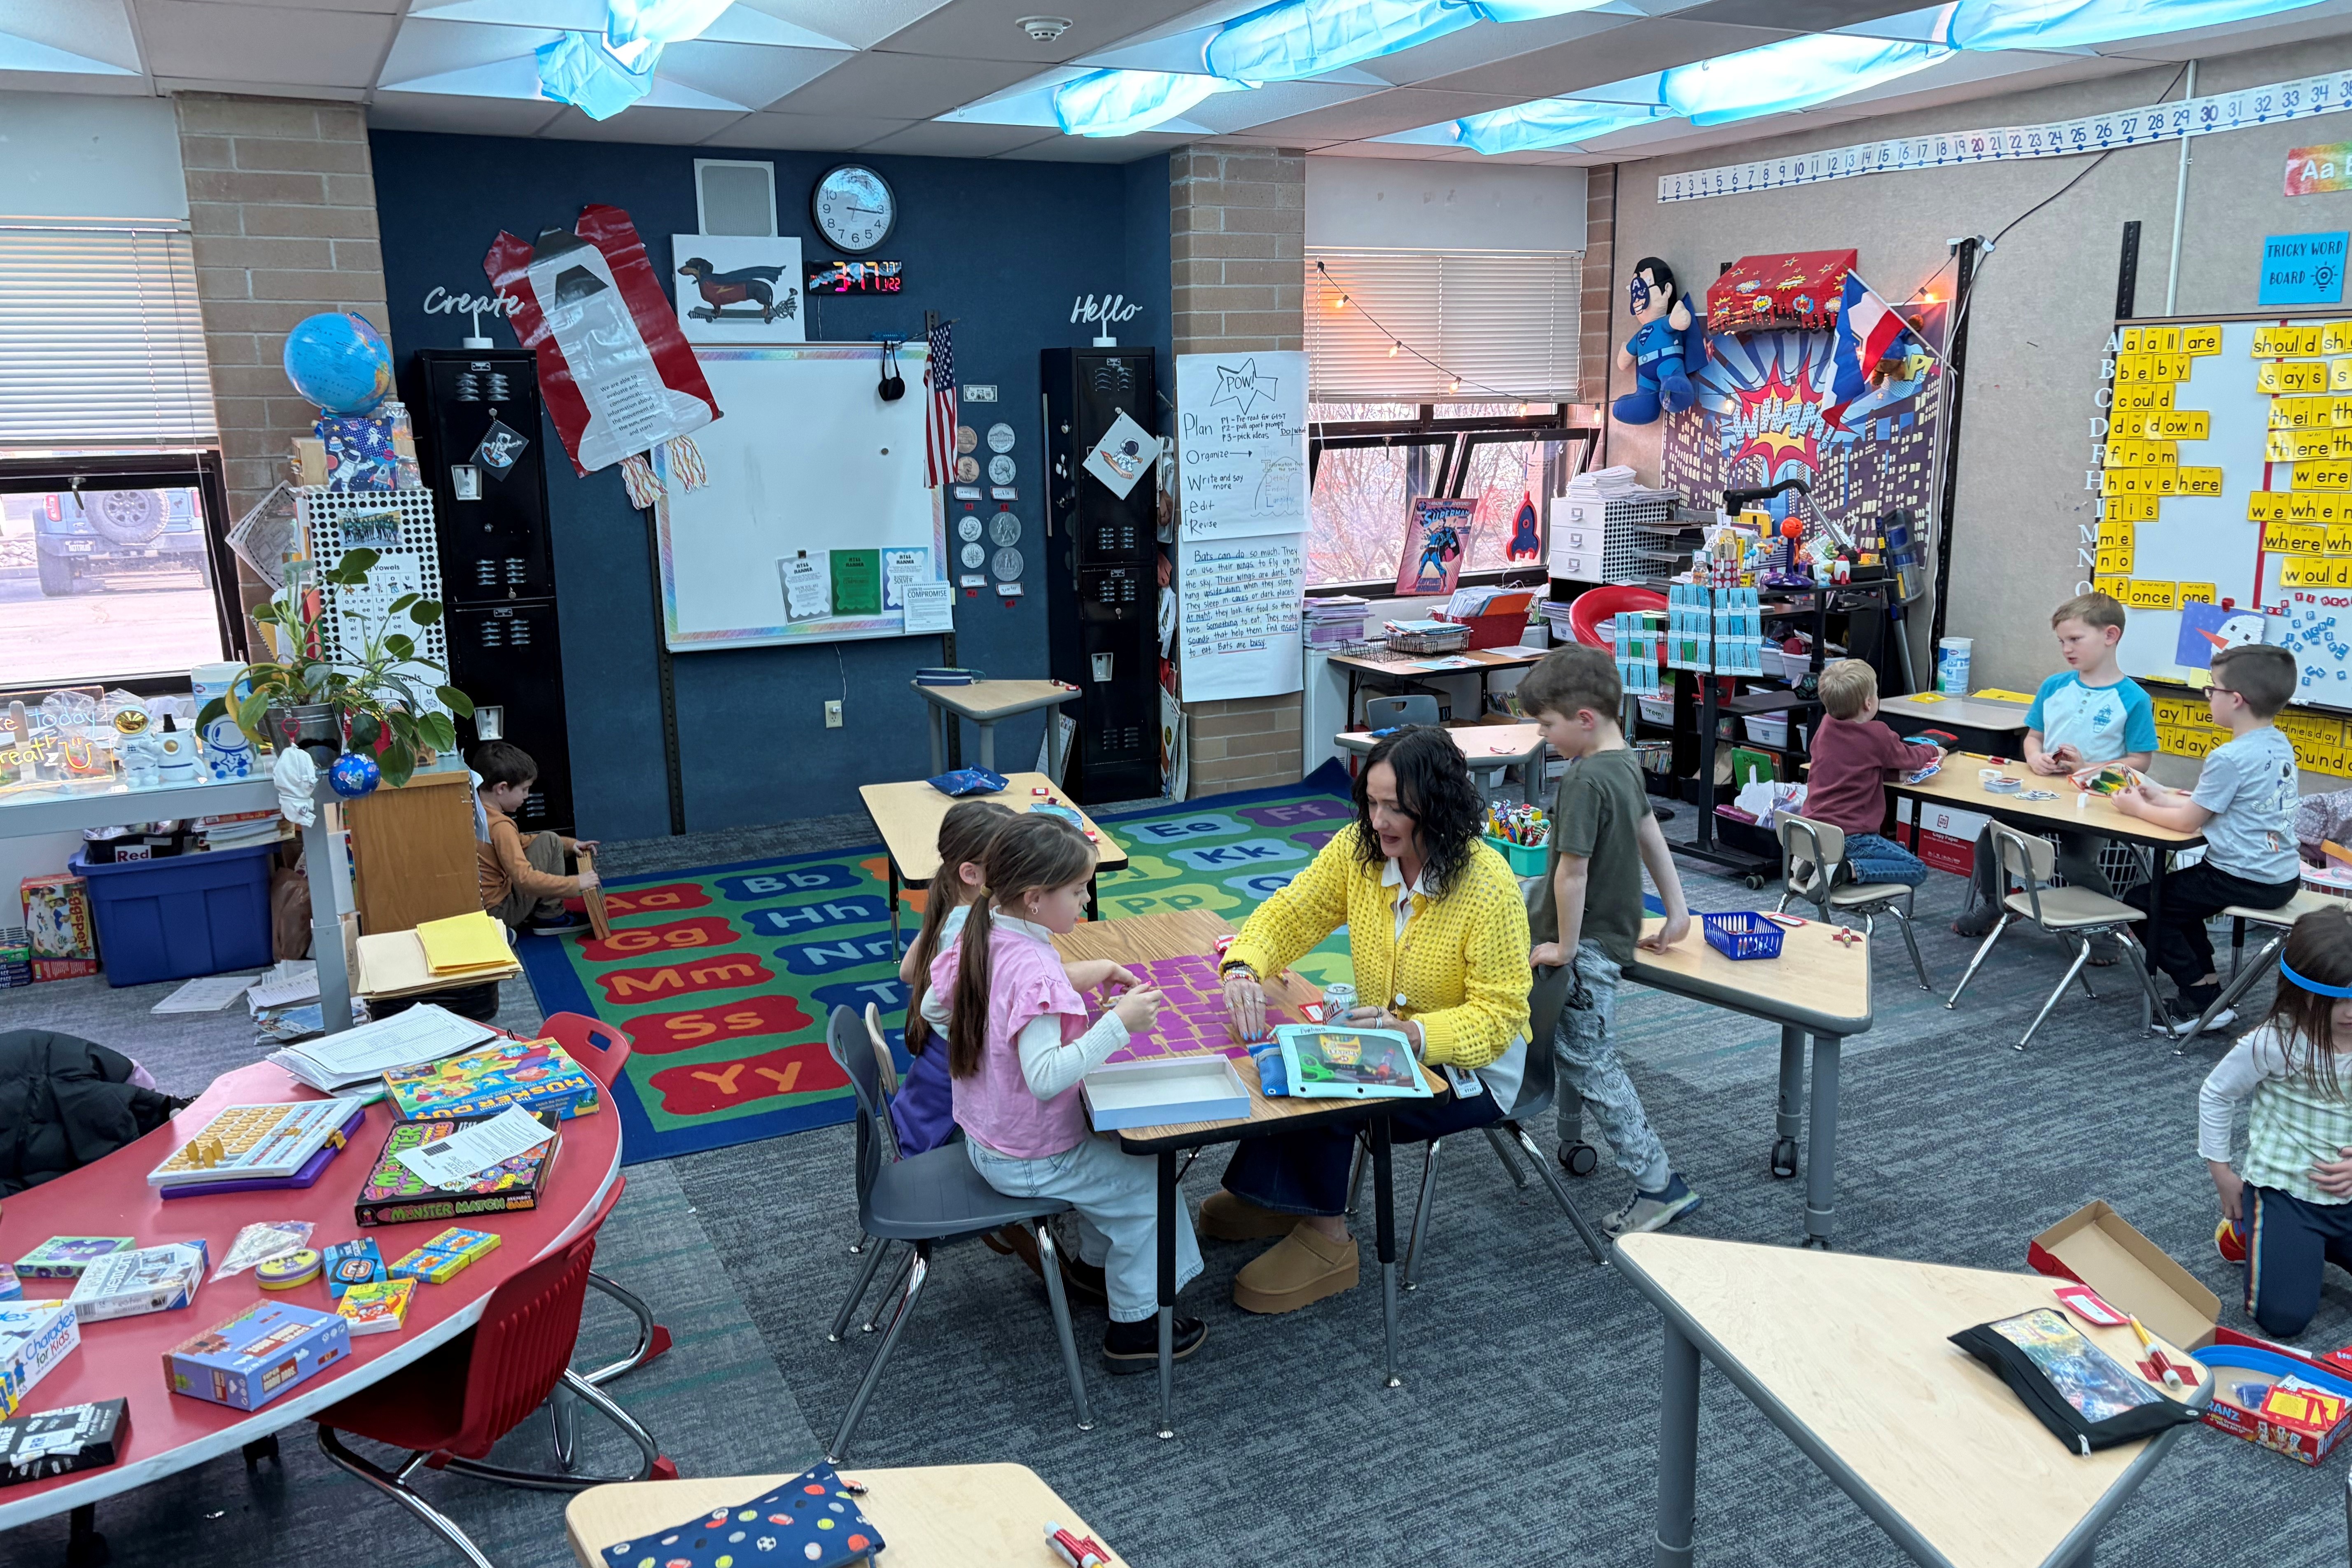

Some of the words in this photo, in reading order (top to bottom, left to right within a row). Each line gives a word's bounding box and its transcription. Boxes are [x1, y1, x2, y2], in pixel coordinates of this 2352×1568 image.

[1794, 162, 1804, 176] 10
[1878, 148, 1889, 162] 15
[1898, 146, 1909, 160] 16
[1918, 144, 1927, 158] 17
[1971, 138, 1984, 152] 20
[2028, 134, 2042, 147] 23
[2048, 131, 2063, 145] 24
[2070, 128, 2086, 142] 25
[2096, 123, 2112, 139] 26
[2121, 119, 2137, 134] 27
[2148, 114, 2164, 130] 28
[2173, 110, 2190, 127] 29
[2200, 105, 2219, 122] 30
[2228, 101, 2242, 117] 31
[2254, 96, 2271, 112] 32
[2282, 90, 2299, 107] 33
[2311, 84, 2329, 103] 34
[2301, 160, 2334, 181] Aa
[826, 192, 837, 200] 10
[823, 204, 831, 214] 9
[828, 218, 835, 228] 8
[852, 233, 860, 243] 6
[865, 230, 872, 239] 5
[2267, 245, 2308, 258] TRICKY
[2311, 240, 2343, 255] WORD
[2269, 271, 2305, 285] BOARD
[423, 286, 525, 318] Create
[1070, 293, 1143, 324] Hello
[2147, 334, 2174, 349] all
[2188, 338, 2215, 348] are
[2253, 335, 2316, 352] should
[2120, 364, 2147, 380] be
[2158, 360, 2185, 378] by
[1227, 371, 1255, 392] POW!
[2266, 373, 2320, 388] says
[607, 387, 628, 399] evaluate
[610, 391, 643, 407] communicate
[2119, 390, 2170, 407] could
[607, 402, 637, 418] information
[637, 396, 652, 405] about
[622, 406, 649, 420] movement
[2114, 418, 2140, 433] do
[2150, 416, 2203, 433] down
[2271, 408, 2326, 425] their
[639, 422, 653, 432] stars!
[1184, 413, 1213, 440] Plan
[1237, 423, 1247, 432] pull
[1249, 422, 1263, 431] apart
[1265, 421, 1284, 431] prompt
[1237, 432, 1251, 442] pick
[1253, 431, 1269, 439] ideas
[2111, 446, 2175, 462] from
[2271, 440, 2328, 456] there
[1186, 450, 1229, 464] Organize
[1188, 474, 1218, 491] Write
[1233, 474, 1244, 485] say
[2108, 475, 2171, 490] have
[2180, 474, 2219, 491] here
[2296, 472, 2348, 483] were
[1423, 508, 1470, 528] SUPERMAN
[2252, 508, 2283, 518] we
[1190, 518, 1217, 535] Revise
[2100, 535, 2128, 545] me
[2265, 532, 2320, 551] where
[1195, 550, 1213, 562] Bats
[1261, 547, 1280, 556] much.
[1281, 546, 1297, 557] They
[2101, 557, 2128, 567] no
[1218, 563, 1232, 571] their
[1269, 558, 1278, 569] fly
[1283, 558, 1290, 568] up
[1185, 580, 1196, 589] the
[1200, 579, 1212, 590] sky.
[1216, 575, 1233, 584] Their
[1237, 572, 1255, 581] wings
[1272, 568, 1286, 577] dark.
[1290, 567, 1302, 576] Bats
[2286, 566, 2347, 583] would
[1185, 592, 1199, 601] hang
[1262, 579, 1274, 589] they
[1278, 578, 1293, 587] sleep.
[1186, 602, 1200, 611] They
[1277, 589, 1297, 597] places.
[2132, 593, 2171, 604] once
[2182, 593, 2210, 604] one
[1216, 609, 1227, 618] they
[1257, 603, 1268, 612] food
[1281, 601, 1291, 612] they
[1265, 614, 1279, 623] They
[1214, 630, 1228, 640] that
[1231, 629, 1244, 638] help
[1218, 642, 1232, 650] Bats
[28, 707, 95, 737] today
[117, 849, 149, 863] Red
[742, 873, 830, 894] Bb
[1144, 822, 1221, 838] Ee
[604, 928, 708, 950] Gg
[767, 903, 869, 929] Hh
[1193, 845, 1280, 864] Kk
[69, 888, 91, 954] Eggspert
[611, 964, 755, 996] Mm
[665, 1012, 764, 1040] Ss
[691, 1061, 802, 1094] Yy
[392, 1204, 452, 1220] MONSTER
[456, 1197, 505, 1213] MATCH
[506, 1199, 534, 1209] GAME
[103, 1252, 142, 1294] memory
[26, 1310, 75, 1360] Charades
[37, 1348, 48, 1367] for
[51, 1330, 70, 1356] Kids
